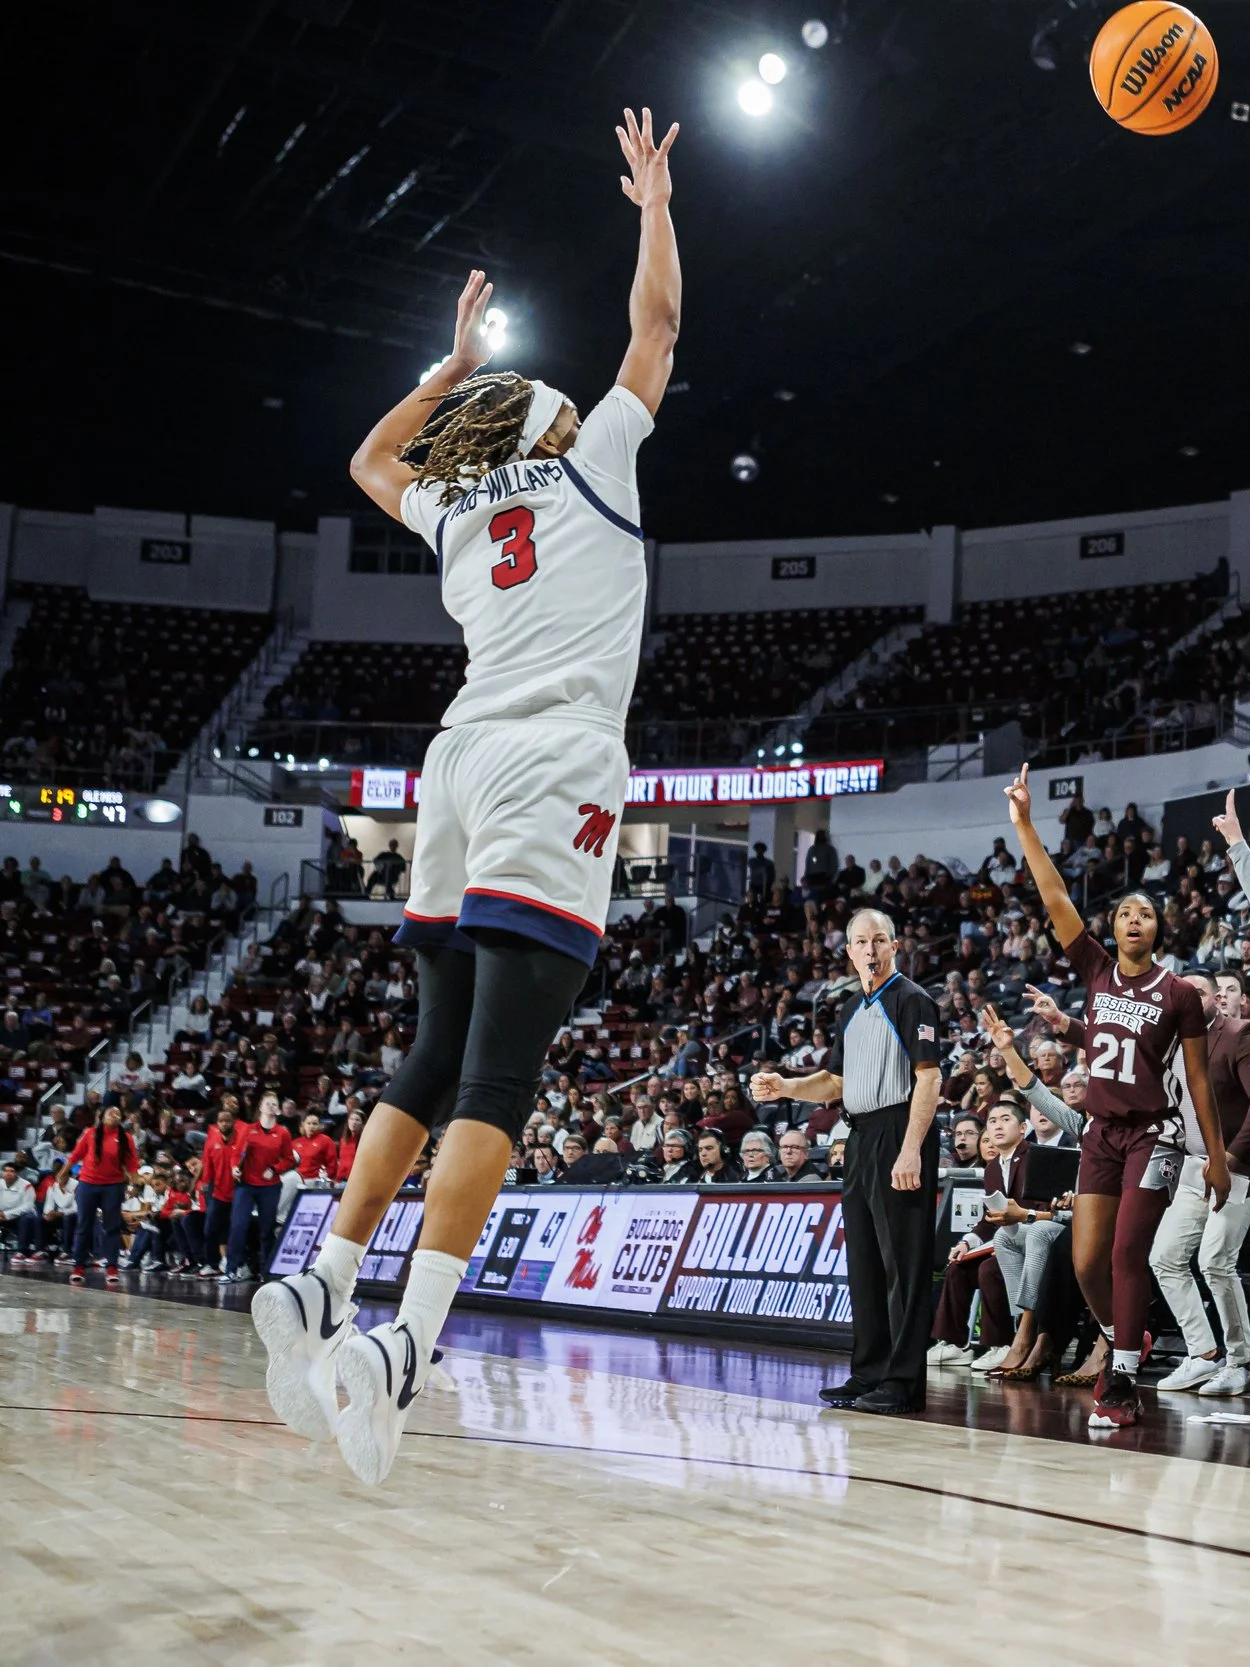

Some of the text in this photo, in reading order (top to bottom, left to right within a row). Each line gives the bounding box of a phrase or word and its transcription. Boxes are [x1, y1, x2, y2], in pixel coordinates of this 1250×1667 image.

[1121, 23, 1184, 95] Wilson
[1162, 52, 1207, 113] NCAA
[488, 505, 538, 591] 3
[780, 560, 808, 576] 205
[367, 787, 402, 798] CLUB
[661, 774, 713, 803] YOUR
[717, 770, 810, 802] BULLDOGS
[814, 765, 879, 796] TODAY!
[1056, 780, 1077, 796] 104
[103, 805, 126, 823] 47
[272, 811, 295, 825] 102
[1093, 996, 1162, 1023] MISSISSIPPI
[1101, 1012, 1136, 1028] STATE
[1090, 1032, 1137, 1084] 21
[539, 1211, 568, 1248] 47
[625, 1218, 684, 1242] BULLDOG
[682, 1203, 825, 1274] BULLDOG
[612, 1244, 673, 1282] CLUB
[667, 1275, 728, 1312] SUPPORT
[722, 1277, 764, 1315] YOUR
[756, 1279, 833, 1320] BULLDOGS
